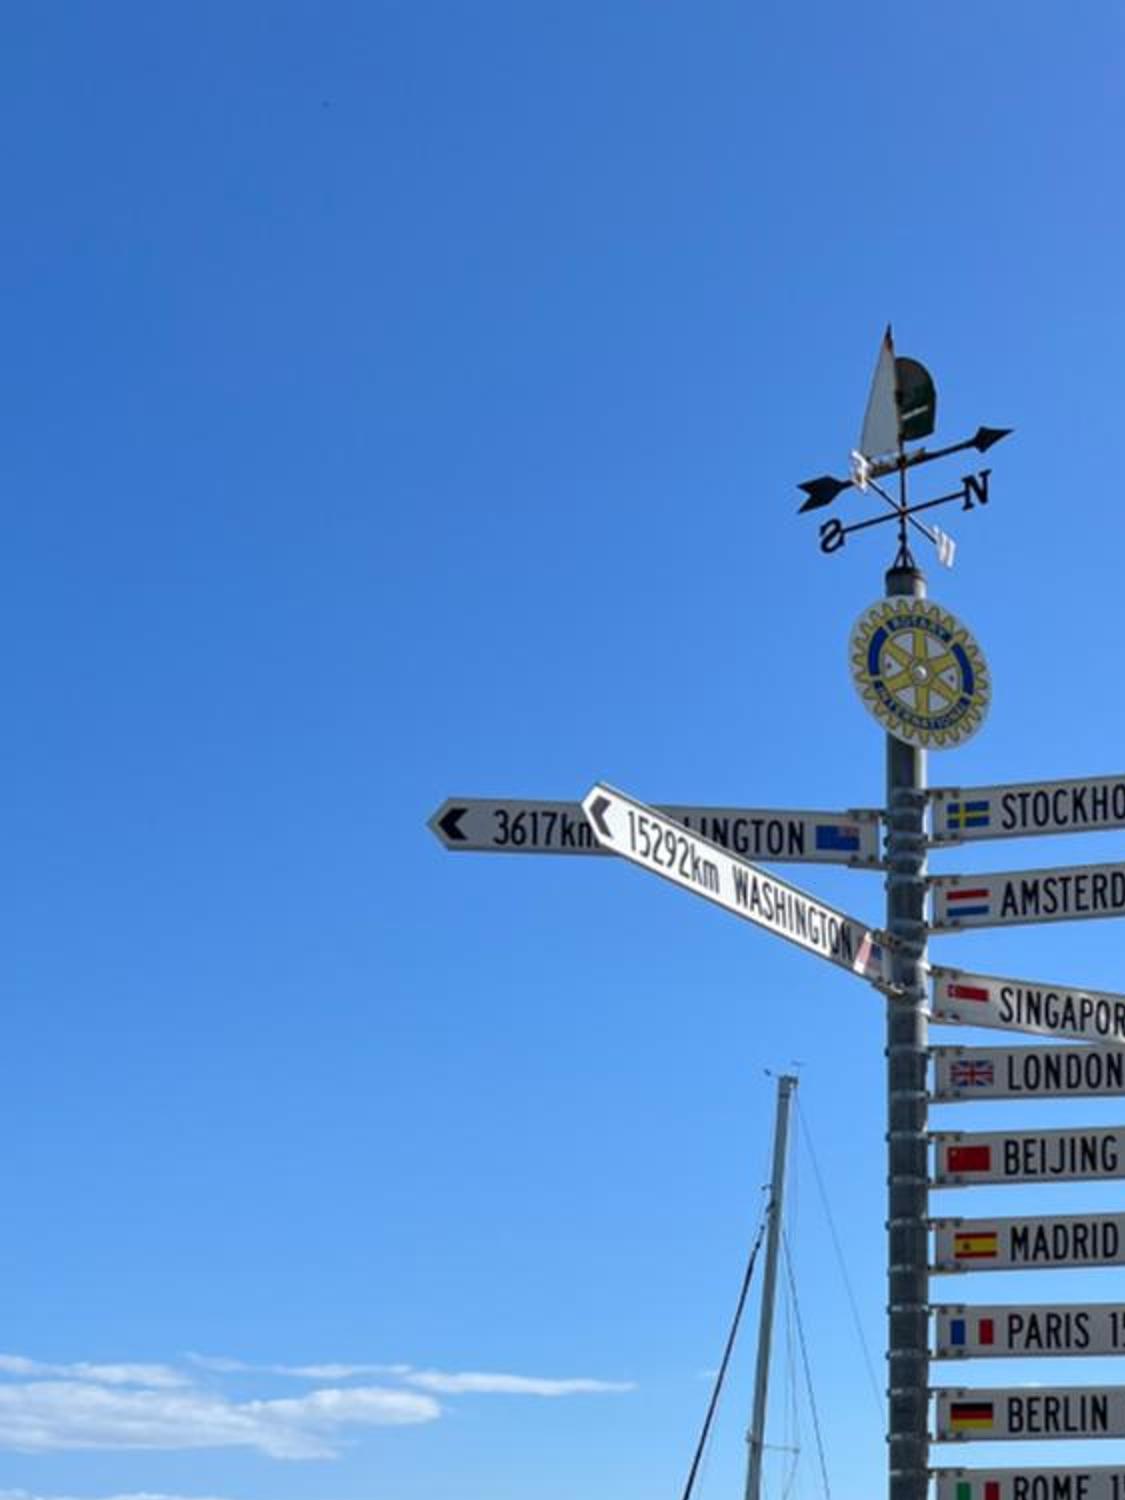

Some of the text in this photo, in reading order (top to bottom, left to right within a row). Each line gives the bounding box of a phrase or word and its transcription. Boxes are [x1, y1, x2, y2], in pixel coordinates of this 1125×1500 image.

[962, 468, 992, 512] N
[492, 809, 804, 856] 3617km INGTON
[628, 810, 853, 961] 15292km WASHINGTON
[1008, 1052, 1123, 1091] LONDON
[1004, 1136, 1118, 1175] BEIJING
[1010, 1222, 1119, 1262] MADRID
[1008, 1313, 1090, 1350] PARIS
[1008, 1395, 1108, 1432] BERLIN
